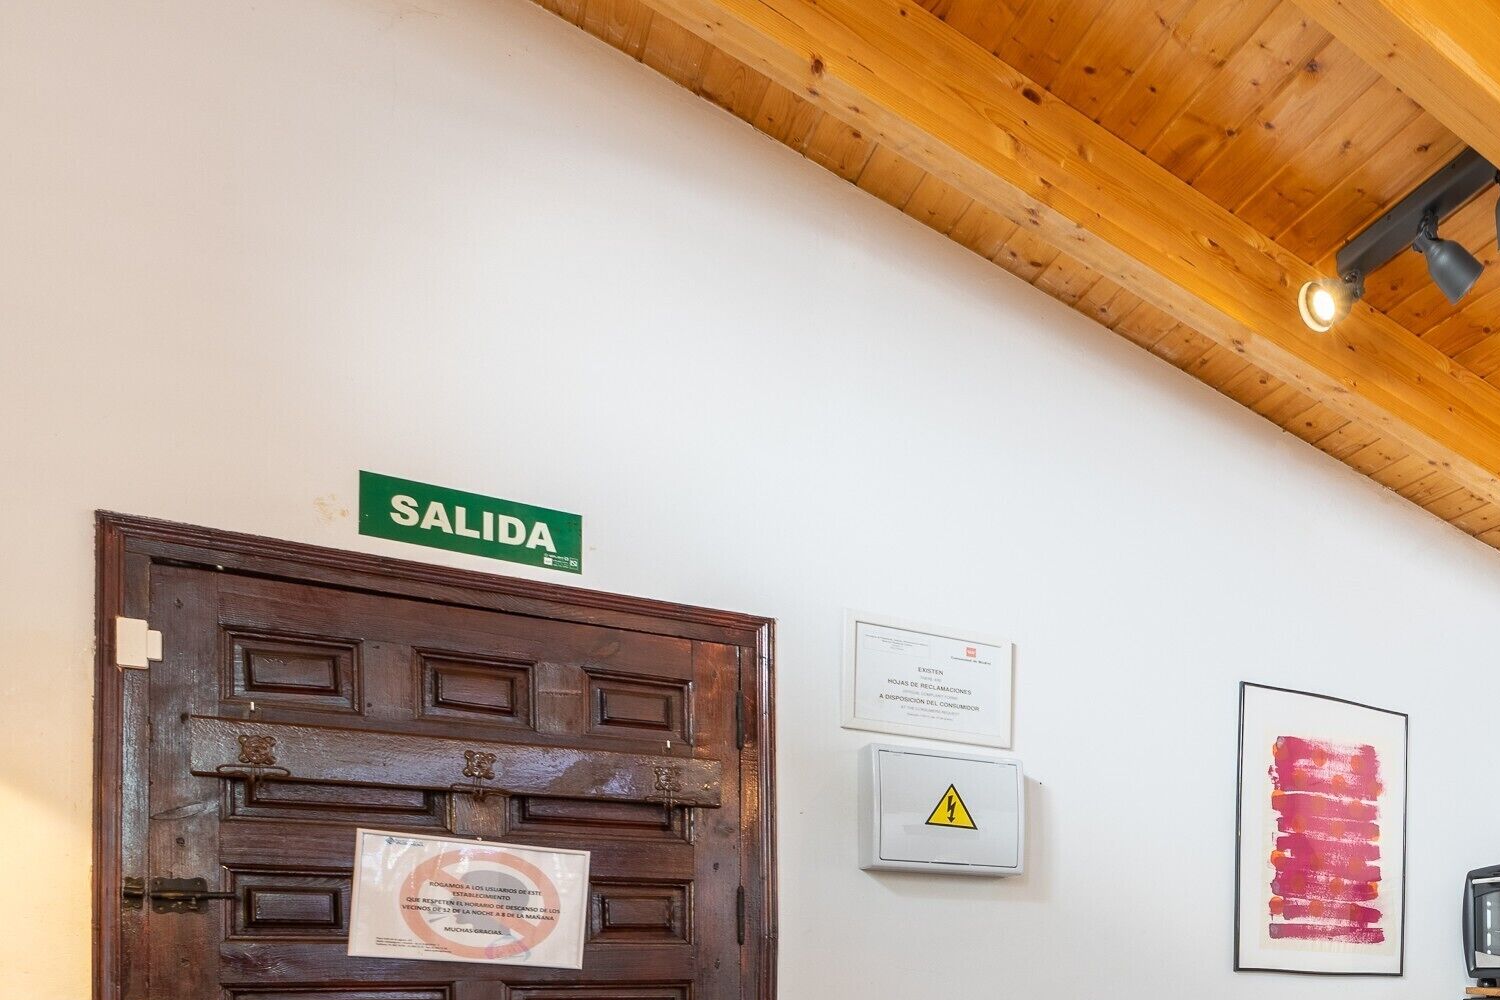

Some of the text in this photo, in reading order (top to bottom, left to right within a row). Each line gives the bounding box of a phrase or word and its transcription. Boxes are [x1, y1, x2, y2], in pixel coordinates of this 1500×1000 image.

[389, 494, 557, 553] SALIDA
[918, 666, 944, 676] EXISTEN
[887, 678, 909, 687] HOJAS
[920, 683, 972, 695] RECLAMACIONES
[939, 701, 980, 711] CONSUMIDOR
[429, 881, 464, 889] ROGAMOS
[485, 886, 517, 894] USUARIOS
[452, 891, 511, 901] ESTABLECIMIENTO
[422, 898, 455, 906] RESPETEN
[505, 904, 538, 913] DESCANSO
